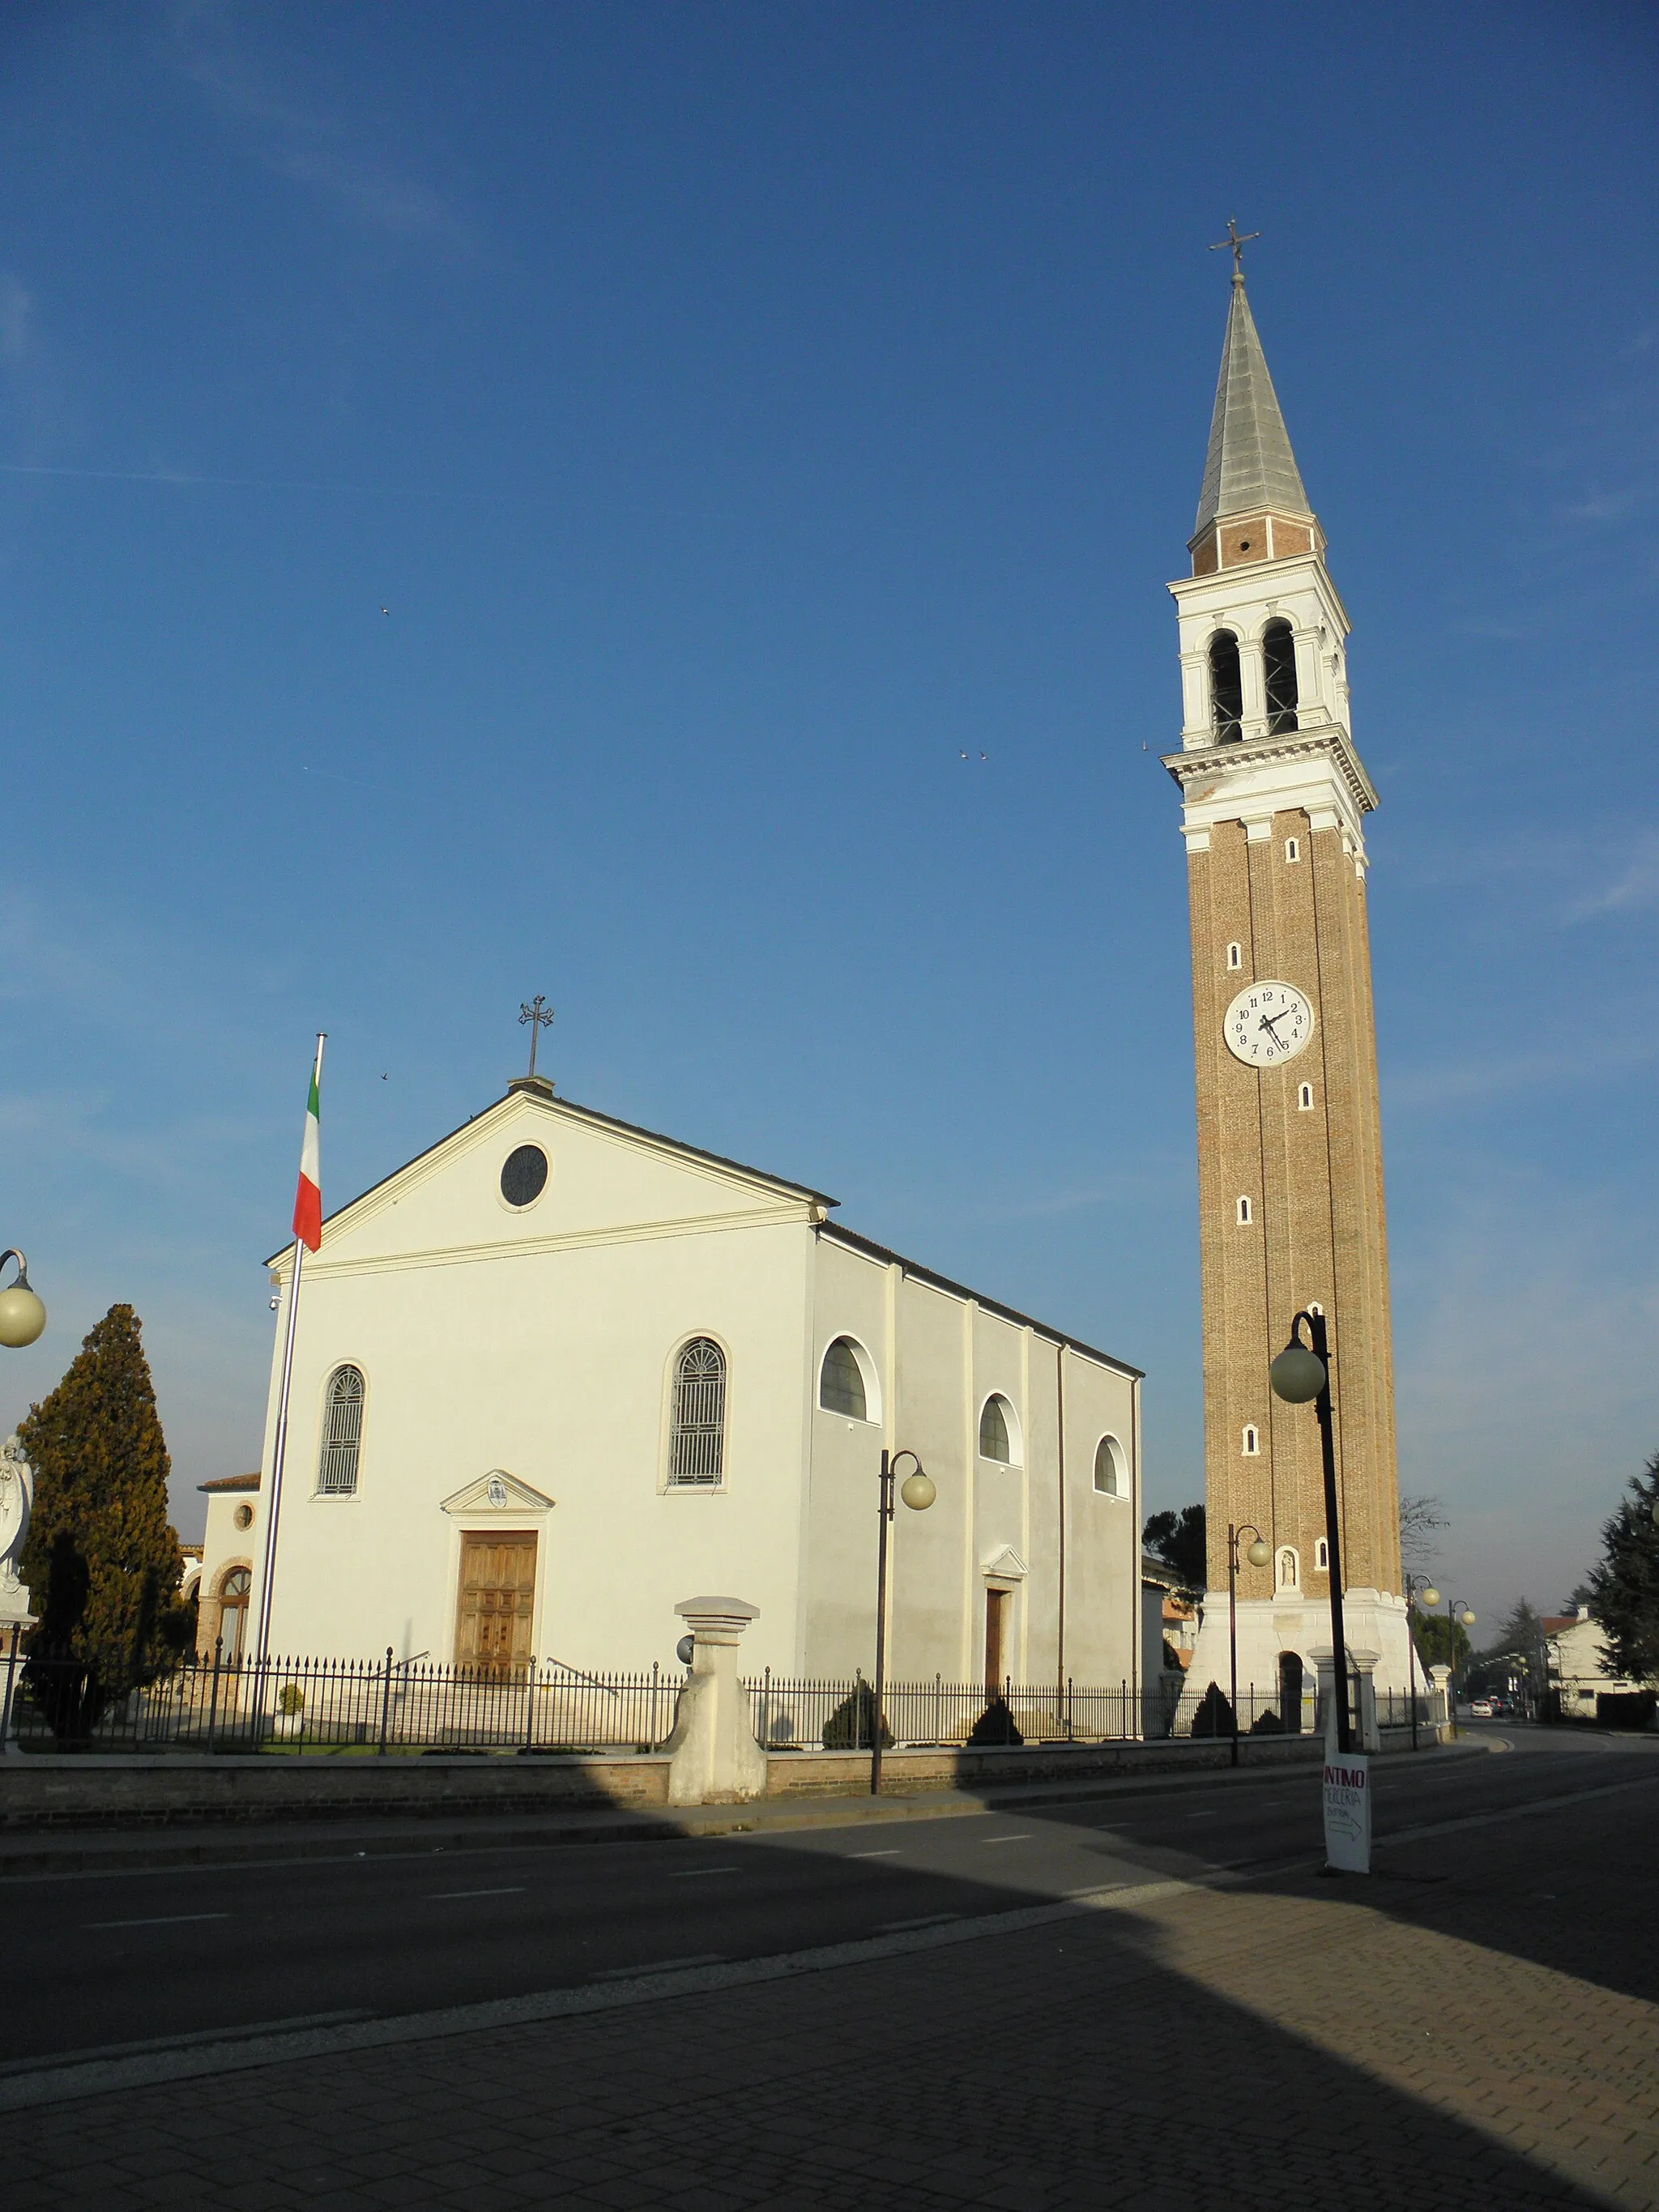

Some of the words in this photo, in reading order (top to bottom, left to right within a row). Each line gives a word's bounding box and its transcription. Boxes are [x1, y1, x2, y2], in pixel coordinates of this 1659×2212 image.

[1262, 991, 1273, 1001] 12
[1281, 995, 1286, 1004] 1
[1250, 998, 1257, 1008] 11
[1290, 1003, 1298, 1012] 2
[1239, 1009, 1249, 1019] 10
[1295, 1016, 1302, 1025] 3
[1236, 1024, 1243, 1033] 9
[1291, 1029, 1298, 1038] 4
[1240, 1035, 1247, 1045] 8
[1282, 1040, 1290, 1050] 5
[1252, 1044, 1259, 1054] 7
[1267, 1047, 1273, 1056] 6
[1324, 1766, 1364, 1788] INTIMO
